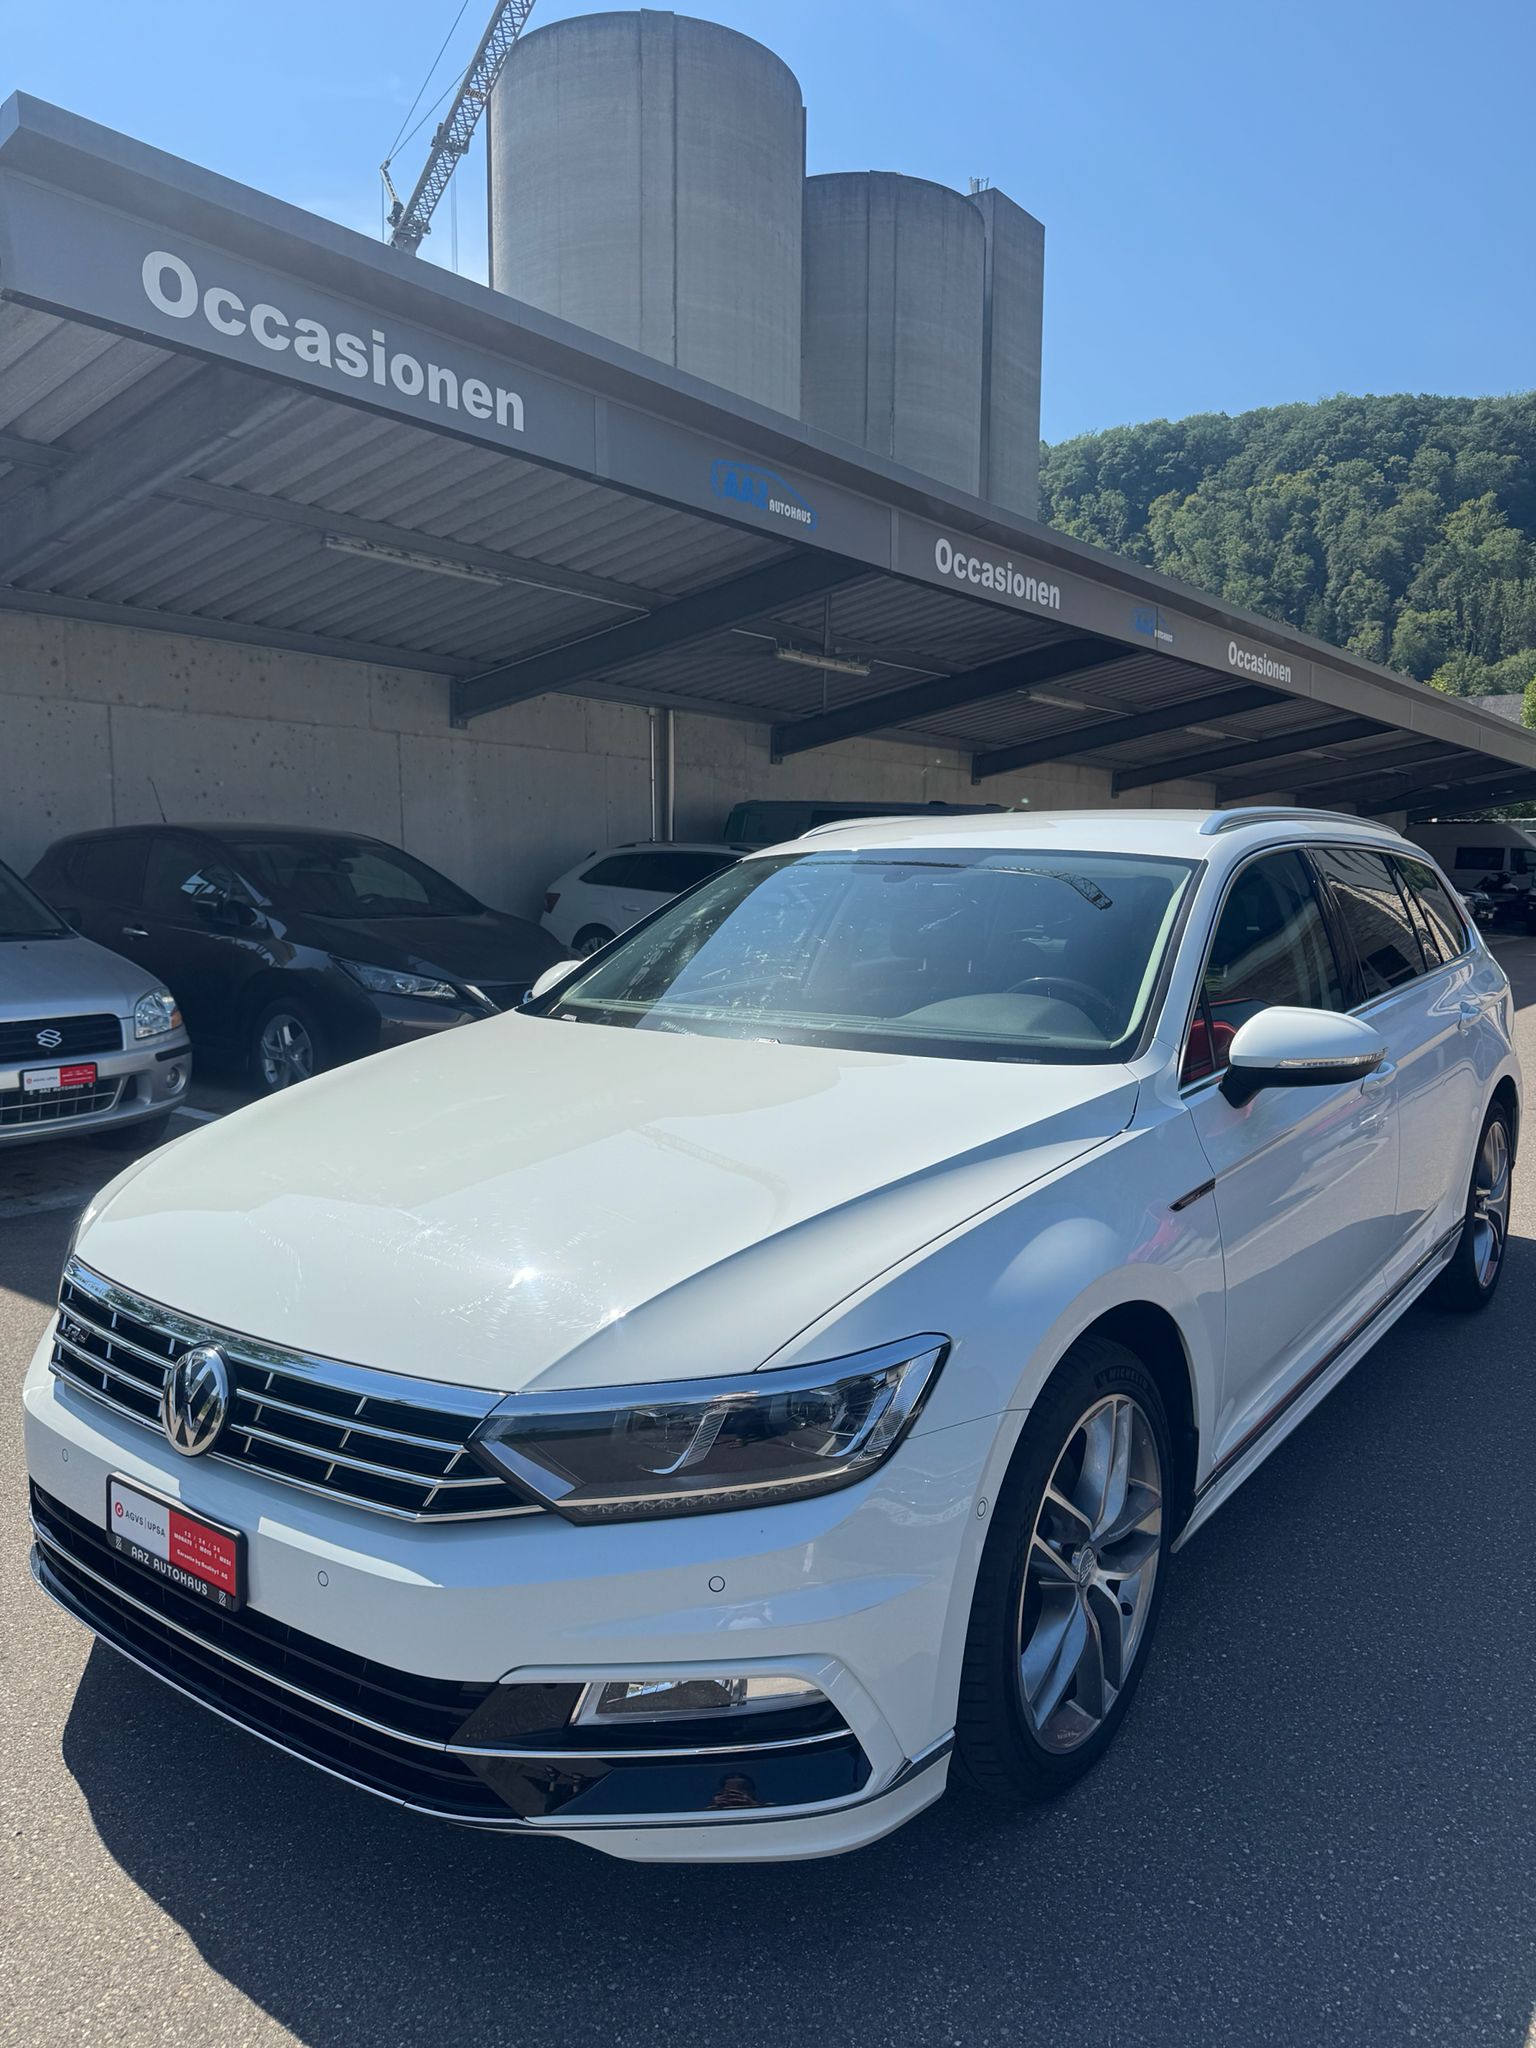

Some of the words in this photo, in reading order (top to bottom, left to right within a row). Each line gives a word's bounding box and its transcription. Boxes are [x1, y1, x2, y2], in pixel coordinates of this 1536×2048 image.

[142, 251, 524, 432] Occasionen
[769, 499, 811, 524] AUTOHAUS
[935, 538, 1060, 610] Occasionen
[1228, 641, 1291, 683] Occasionen
[1108, 1367, 1148, 1390] MICHELIN
[125, 1510, 145, 1526] AGVS
[147, 1521, 166, 1538] UPSA
[131, 1546, 150, 1565] AAZ
[153, 1558, 208, 1596] AUTOHAUS
